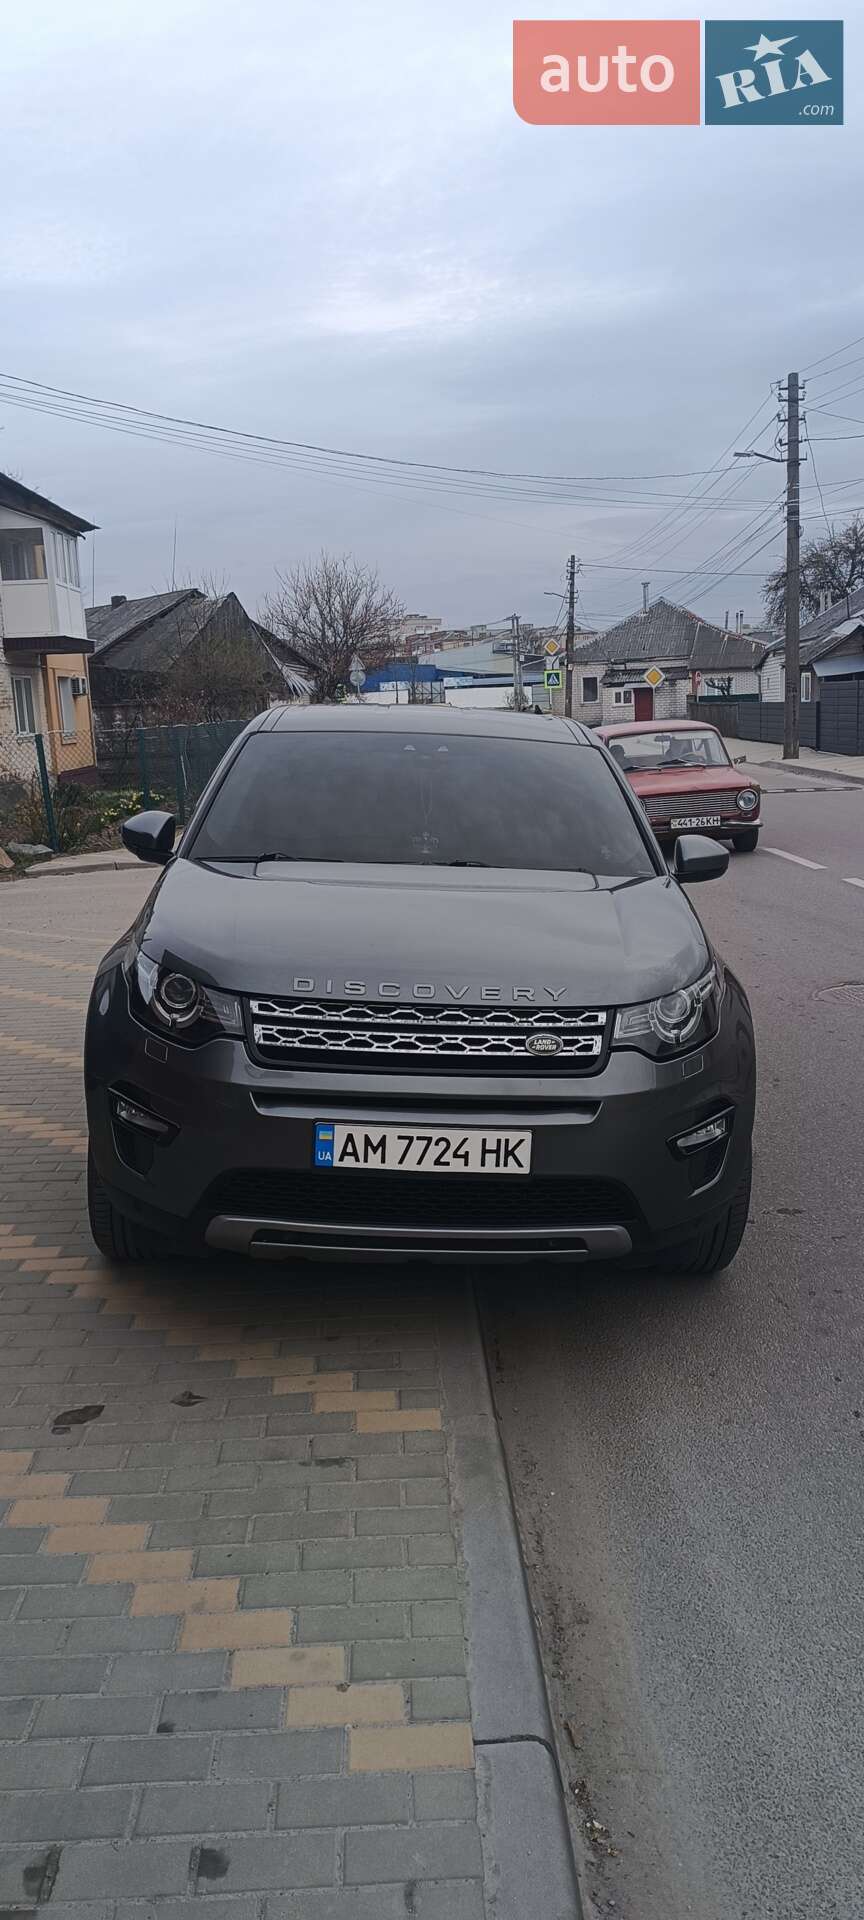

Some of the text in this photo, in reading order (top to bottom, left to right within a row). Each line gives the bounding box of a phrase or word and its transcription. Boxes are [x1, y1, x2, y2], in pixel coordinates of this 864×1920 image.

[292, 977, 568, 1001] DISCOVERY
[318, 1152, 332, 1161] UA
[338, 1133, 526, 1168] AM 7724 HK
